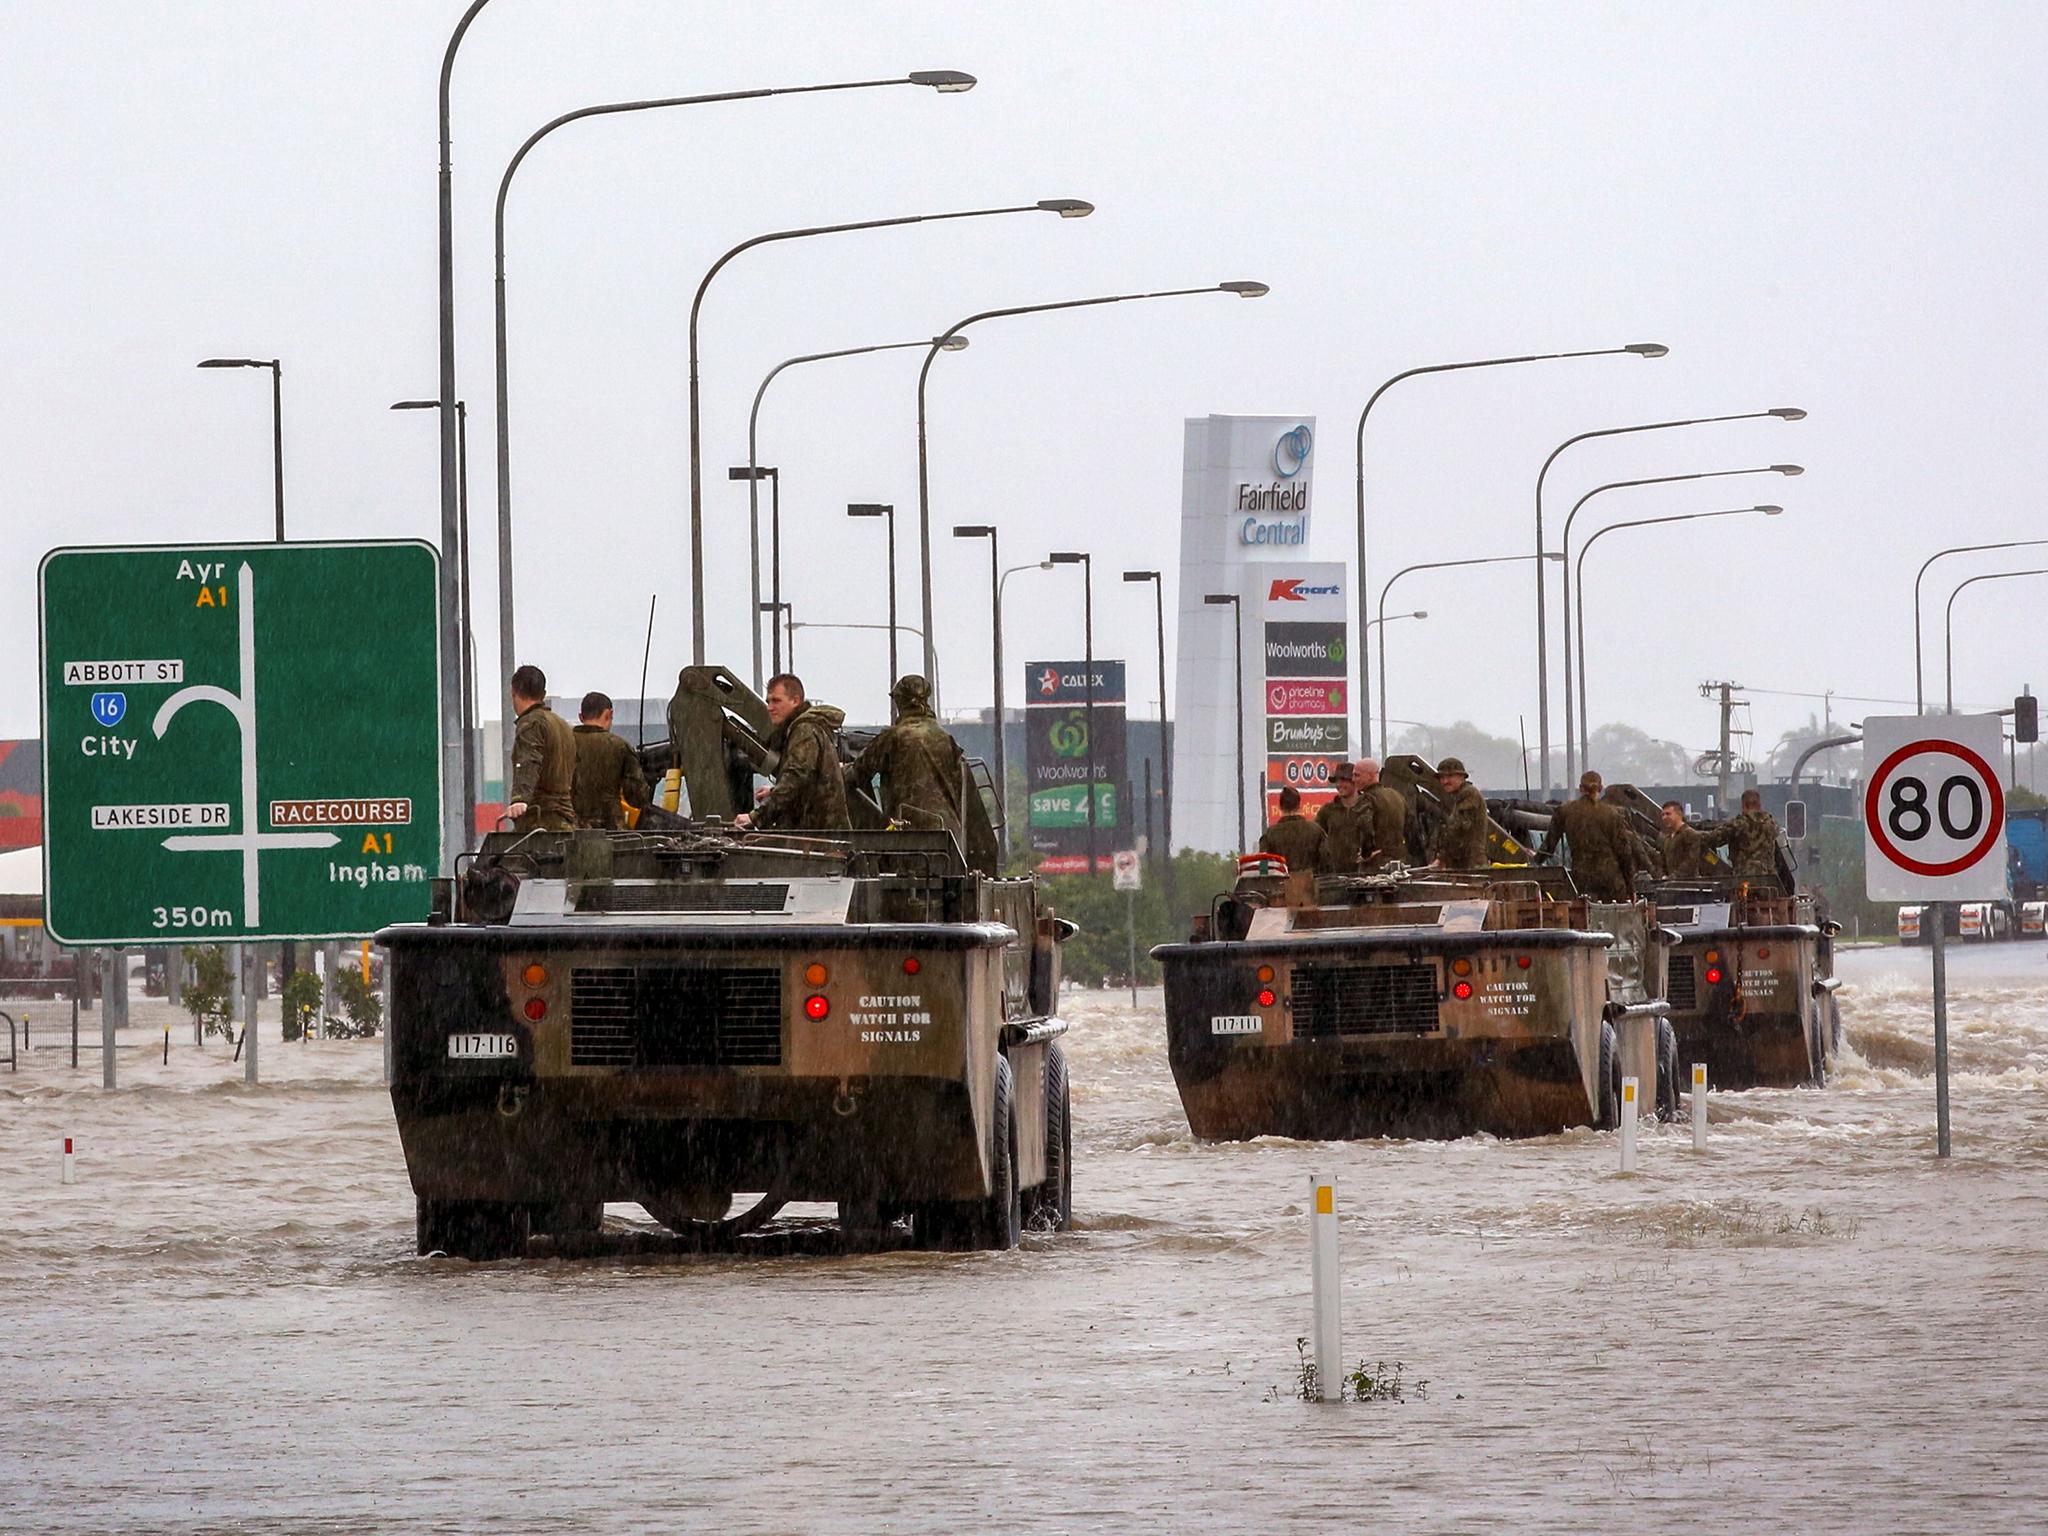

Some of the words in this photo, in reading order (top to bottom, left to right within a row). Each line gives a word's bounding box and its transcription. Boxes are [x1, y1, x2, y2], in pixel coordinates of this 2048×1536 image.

[1238, 482, 1307, 512] Fairfield
[1243, 516, 1305, 545] Central
[176, 559, 226, 585] Ayr
[195, 586, 228, 608] A1
[1268, 579, 1340, 601] Kmart
[1266, 641, 1327, 658] Woolworths
[68, 664, 146, 682] ABBOTT
[157, 662, 180, 680] ST
[1288, 686, 1325, 699] priceline
[99, 697, 119, 717] 16
[1288, 698, 1326, 711] pharmacy
[1273, 721, 1324, 746] Brumby's
[81, 735, 138, 761] City
[1037, 763, 1107, 780] Woolworhs
[274, 802, 407, 823] RACECOURSE
[1033, 797, 1071, 812] save
[1889, 775, 1984, 842] 80
[95, 807, 193, 826] LAKESIDE
[201, 806, 226, 824] DR
[361, 832, 393, 854] A1
[329, 861, 426, 889] Ingham
[152, 906, 233, 928] 350m
[1486, 982, 1529, 992] CAUTION
[859, 995, 921, 1008] CAUTION
[1480, 995, 1513, 1004] WATCH
[1516, 993, 1537, 1003] FOR
[849, 1012, 897, 1025] WATCH
[902, 1012, 931, 1025] FOR
[1488, 1006, 1529, 1016] SIGNALS
[860, 1030, 921, 1042] SIGNALS
